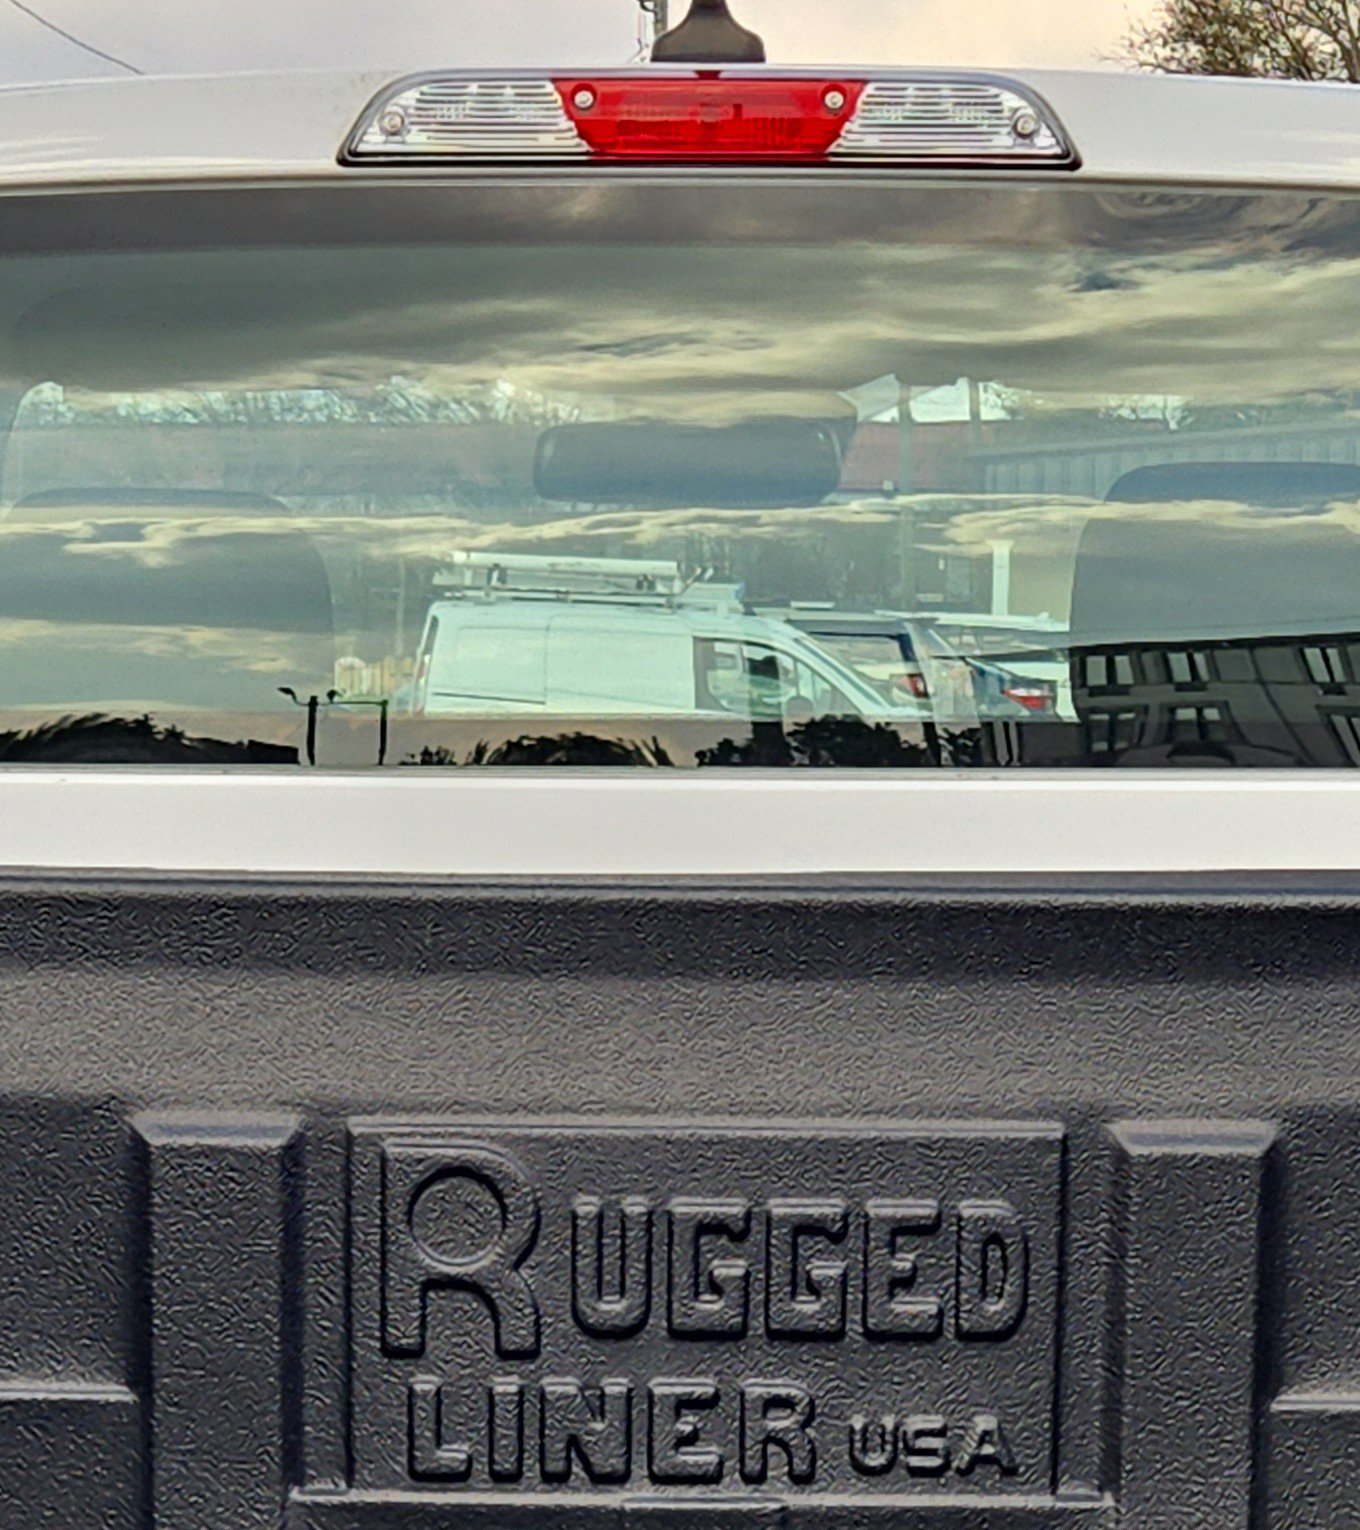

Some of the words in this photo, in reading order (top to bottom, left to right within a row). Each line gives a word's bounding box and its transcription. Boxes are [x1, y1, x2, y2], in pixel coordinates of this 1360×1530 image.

[381, 1139, 1028, 1358] RUGGED
[407, 1375, 817, 1484] LINER
[847, 1414, 1017, 1478] USA
